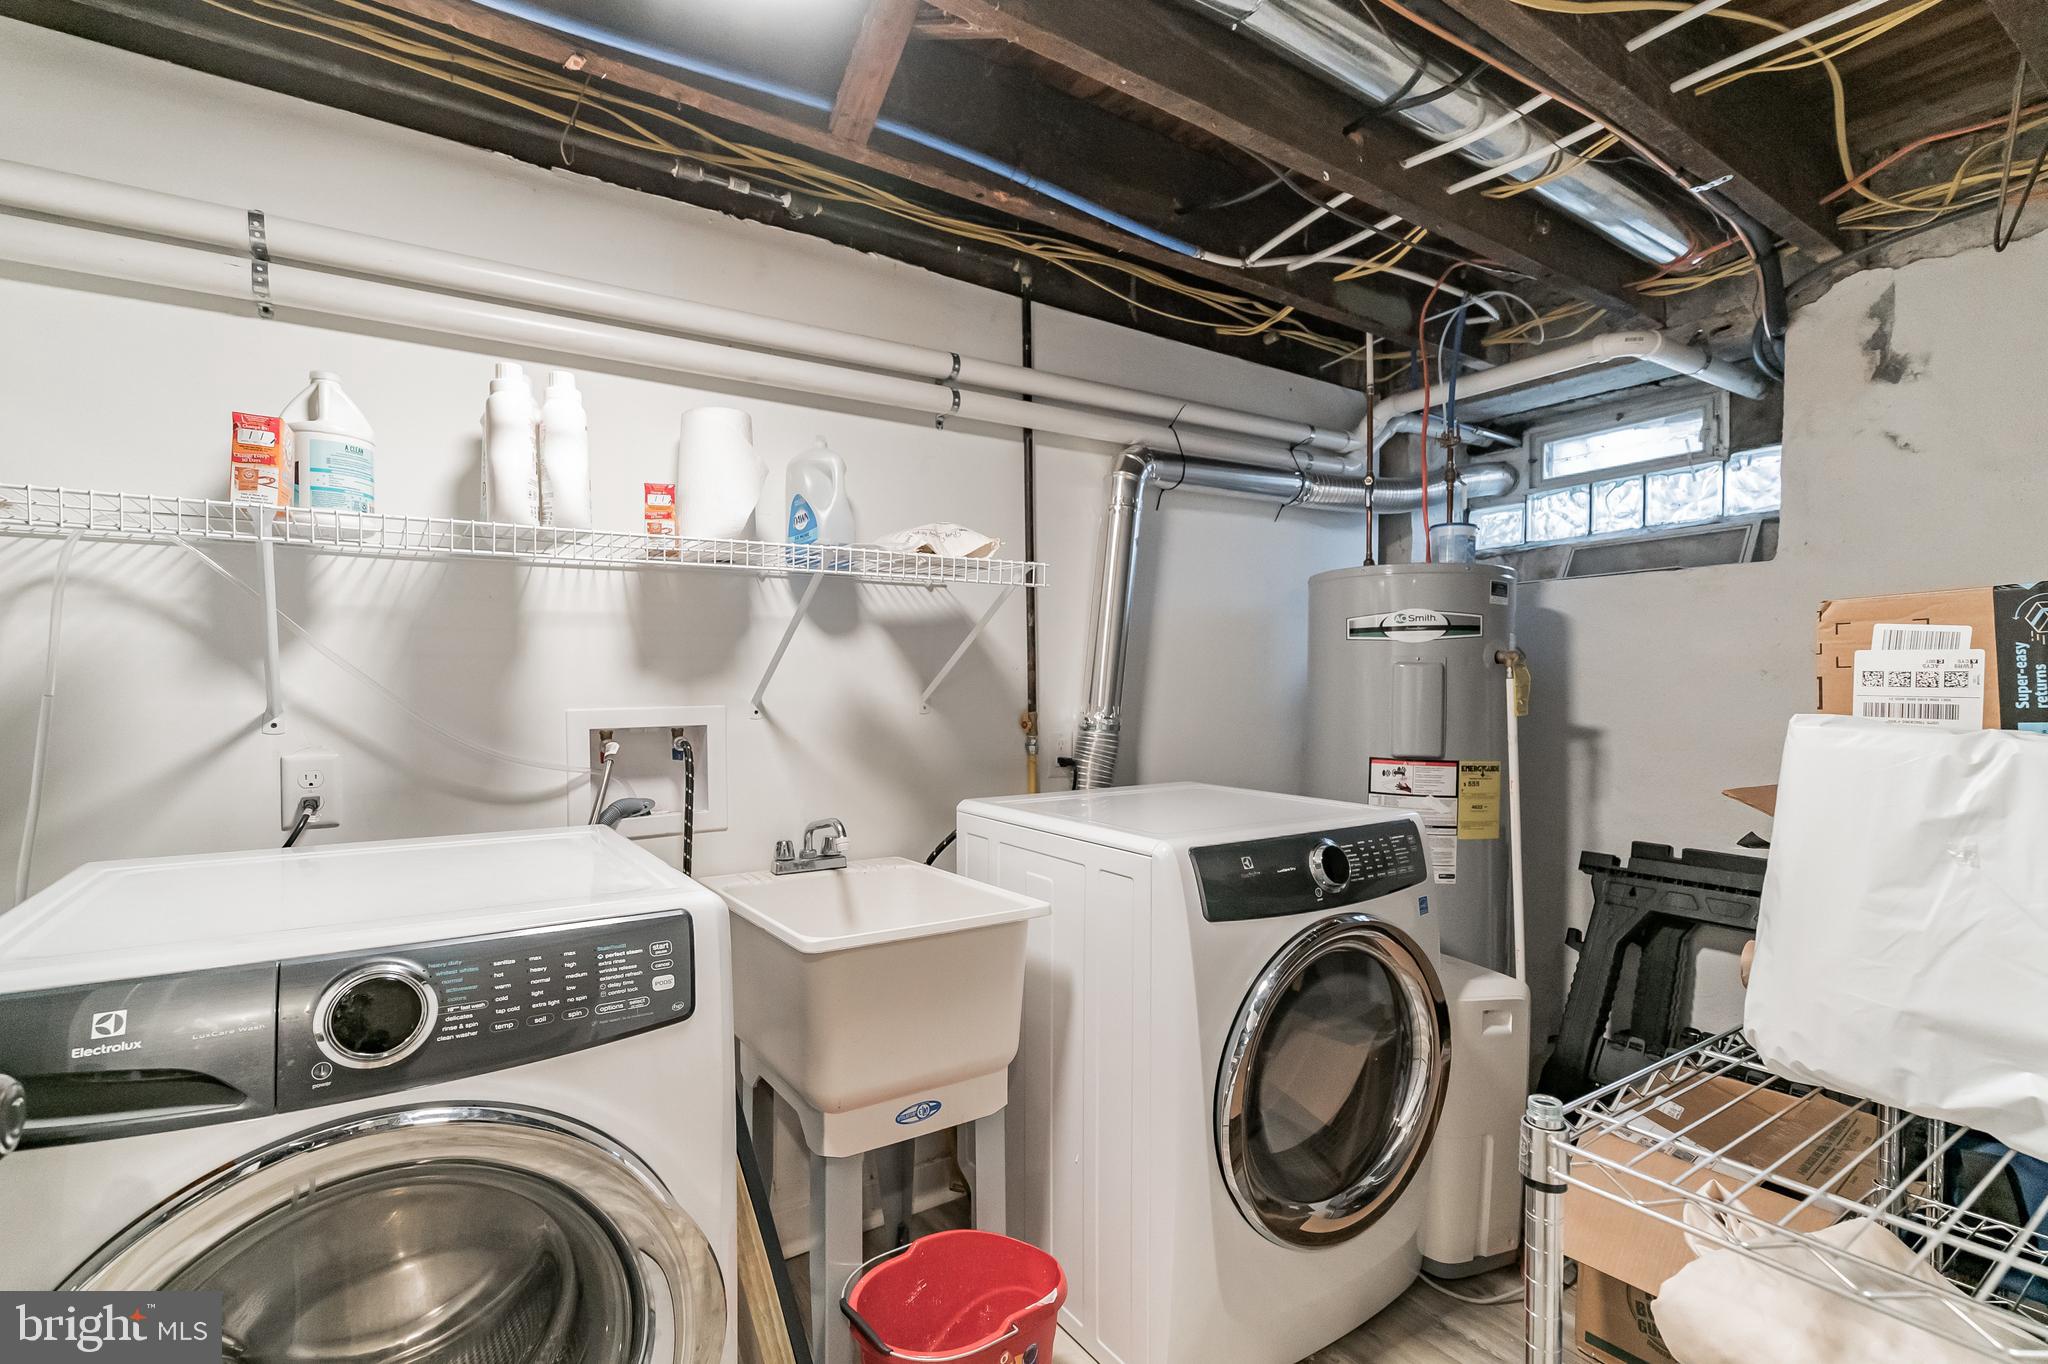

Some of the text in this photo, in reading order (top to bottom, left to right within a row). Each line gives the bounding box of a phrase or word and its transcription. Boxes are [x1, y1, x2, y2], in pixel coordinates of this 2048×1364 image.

[1408, 613, 1436, 622] Smith
[2015, 641, 2032, 709] Super-easy
[2035, 663, 2048, 709] returns
[652, 942, 669, 950] start
[604, 951, 626, 959] perfect
[564, 961, 577, 969] high
[598, 966, 618, 974] wrinkle
[565, 971, 588, 979] medium
[599, 970, 643, 982] extended refresh
[530, 977, 551, 985] normal
[607, 988, 627, 996] control
[495, 994, 509, 1002] cold
[575, 994, 588, 1002] spin
[547, 999, 560, 1007] light
[599, 1003, 624, 1013] options
[445, 1013, 473, 1022] delicates
[567, 1009, 583, 1018] spin
[534, 1016, 547, 1024] soil
[238, 1023, 266, 1034] Wash
[442, 1024, 458, 1032] rinse
[465, 1021, 479, 1030] spin
[494, 1022, 514, 1030] temp
[436, 1031, 478, 1042] clean washer
[71, 1040, 142, 1060] Electrolux
[311, 1080, 332, 1090] power
